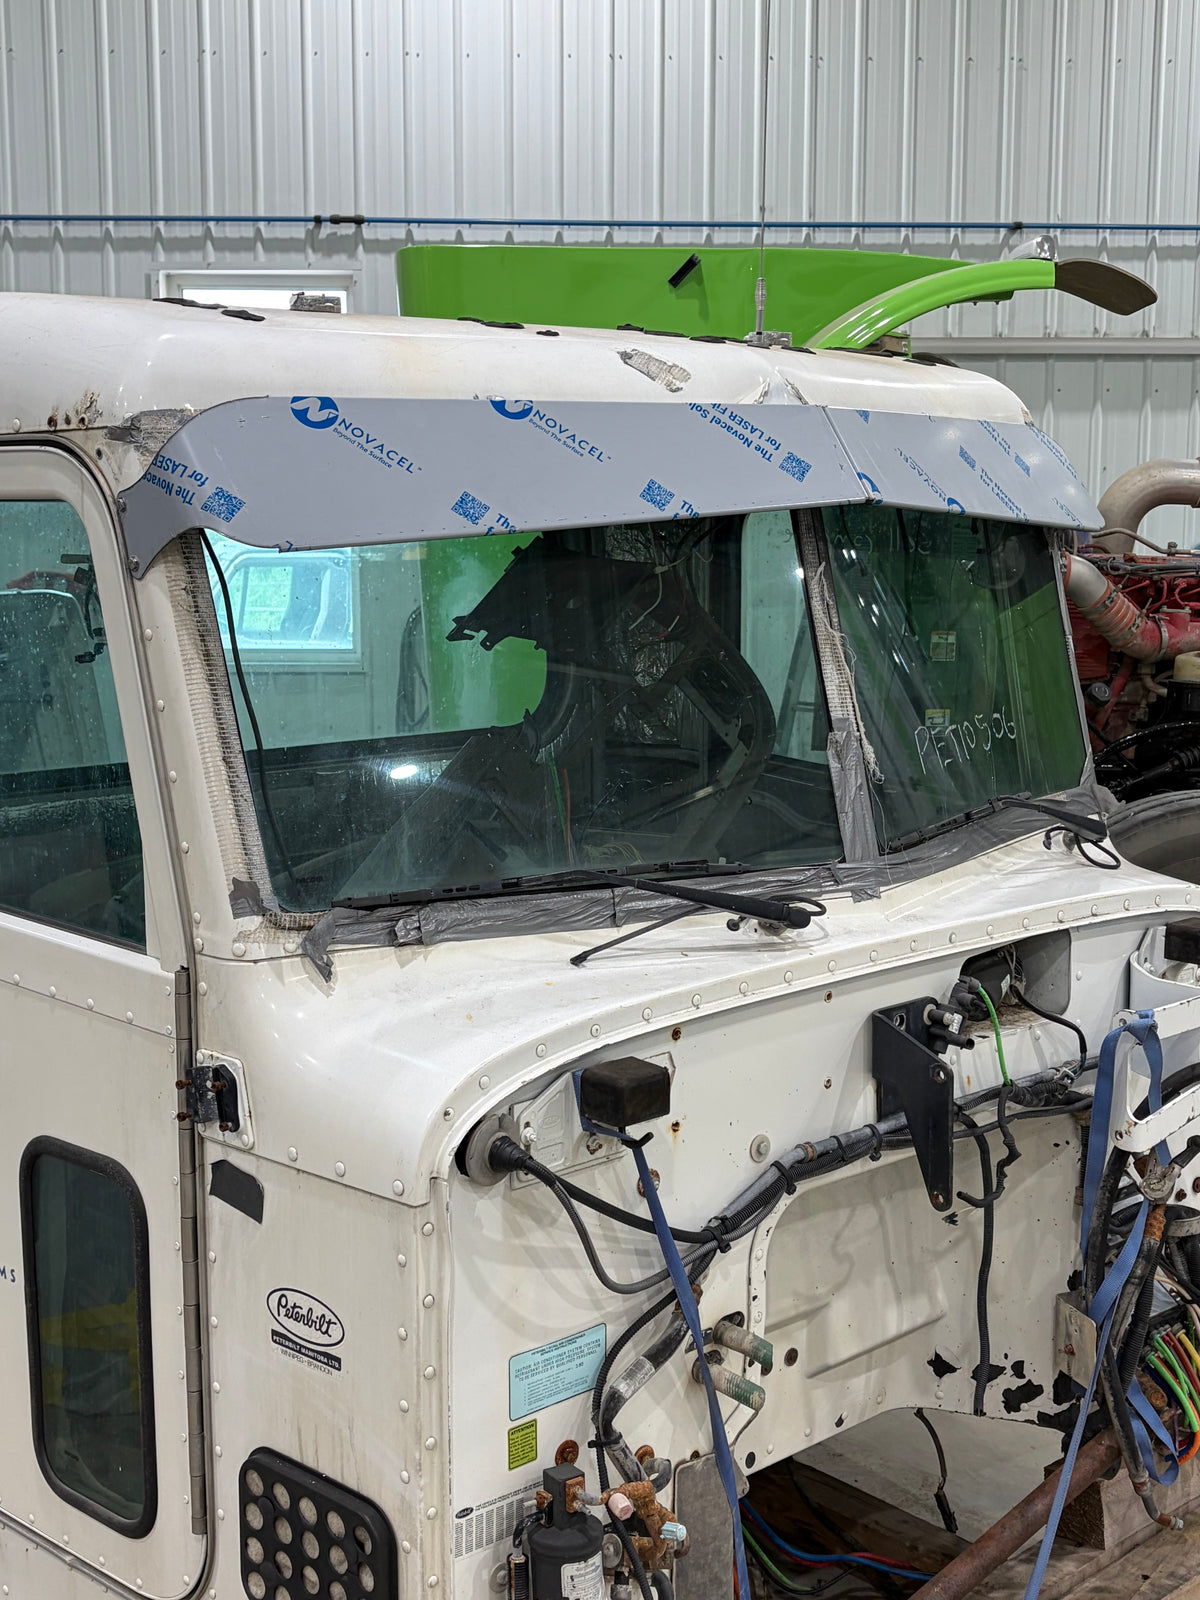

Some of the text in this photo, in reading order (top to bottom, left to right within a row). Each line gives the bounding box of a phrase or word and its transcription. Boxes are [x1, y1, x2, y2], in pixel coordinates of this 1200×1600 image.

[529, 418, 584, 457] Beyond The Surface
[533, 409, 604, 463] NOVACEL
[709, 415, 753, 448] Novacel
[728, 411, 764, 439] LASER
[333, 427, 392, 469] Beyond The Surface
[338, 418, 414, 474] NOVACEL
[754, 443, 773, 462] The
[765, 436, 782, 451] for
[187, 470, 209, 487] for
[897, 448, 946, 502] NOVACEL
[175, 486, 195, 505] The
[277, 1293, 337, 1337] Peterbilt
[273, 1336, 300, 1351] PETERBILT
[300, 1346, 328, 1363] MANITOBA
